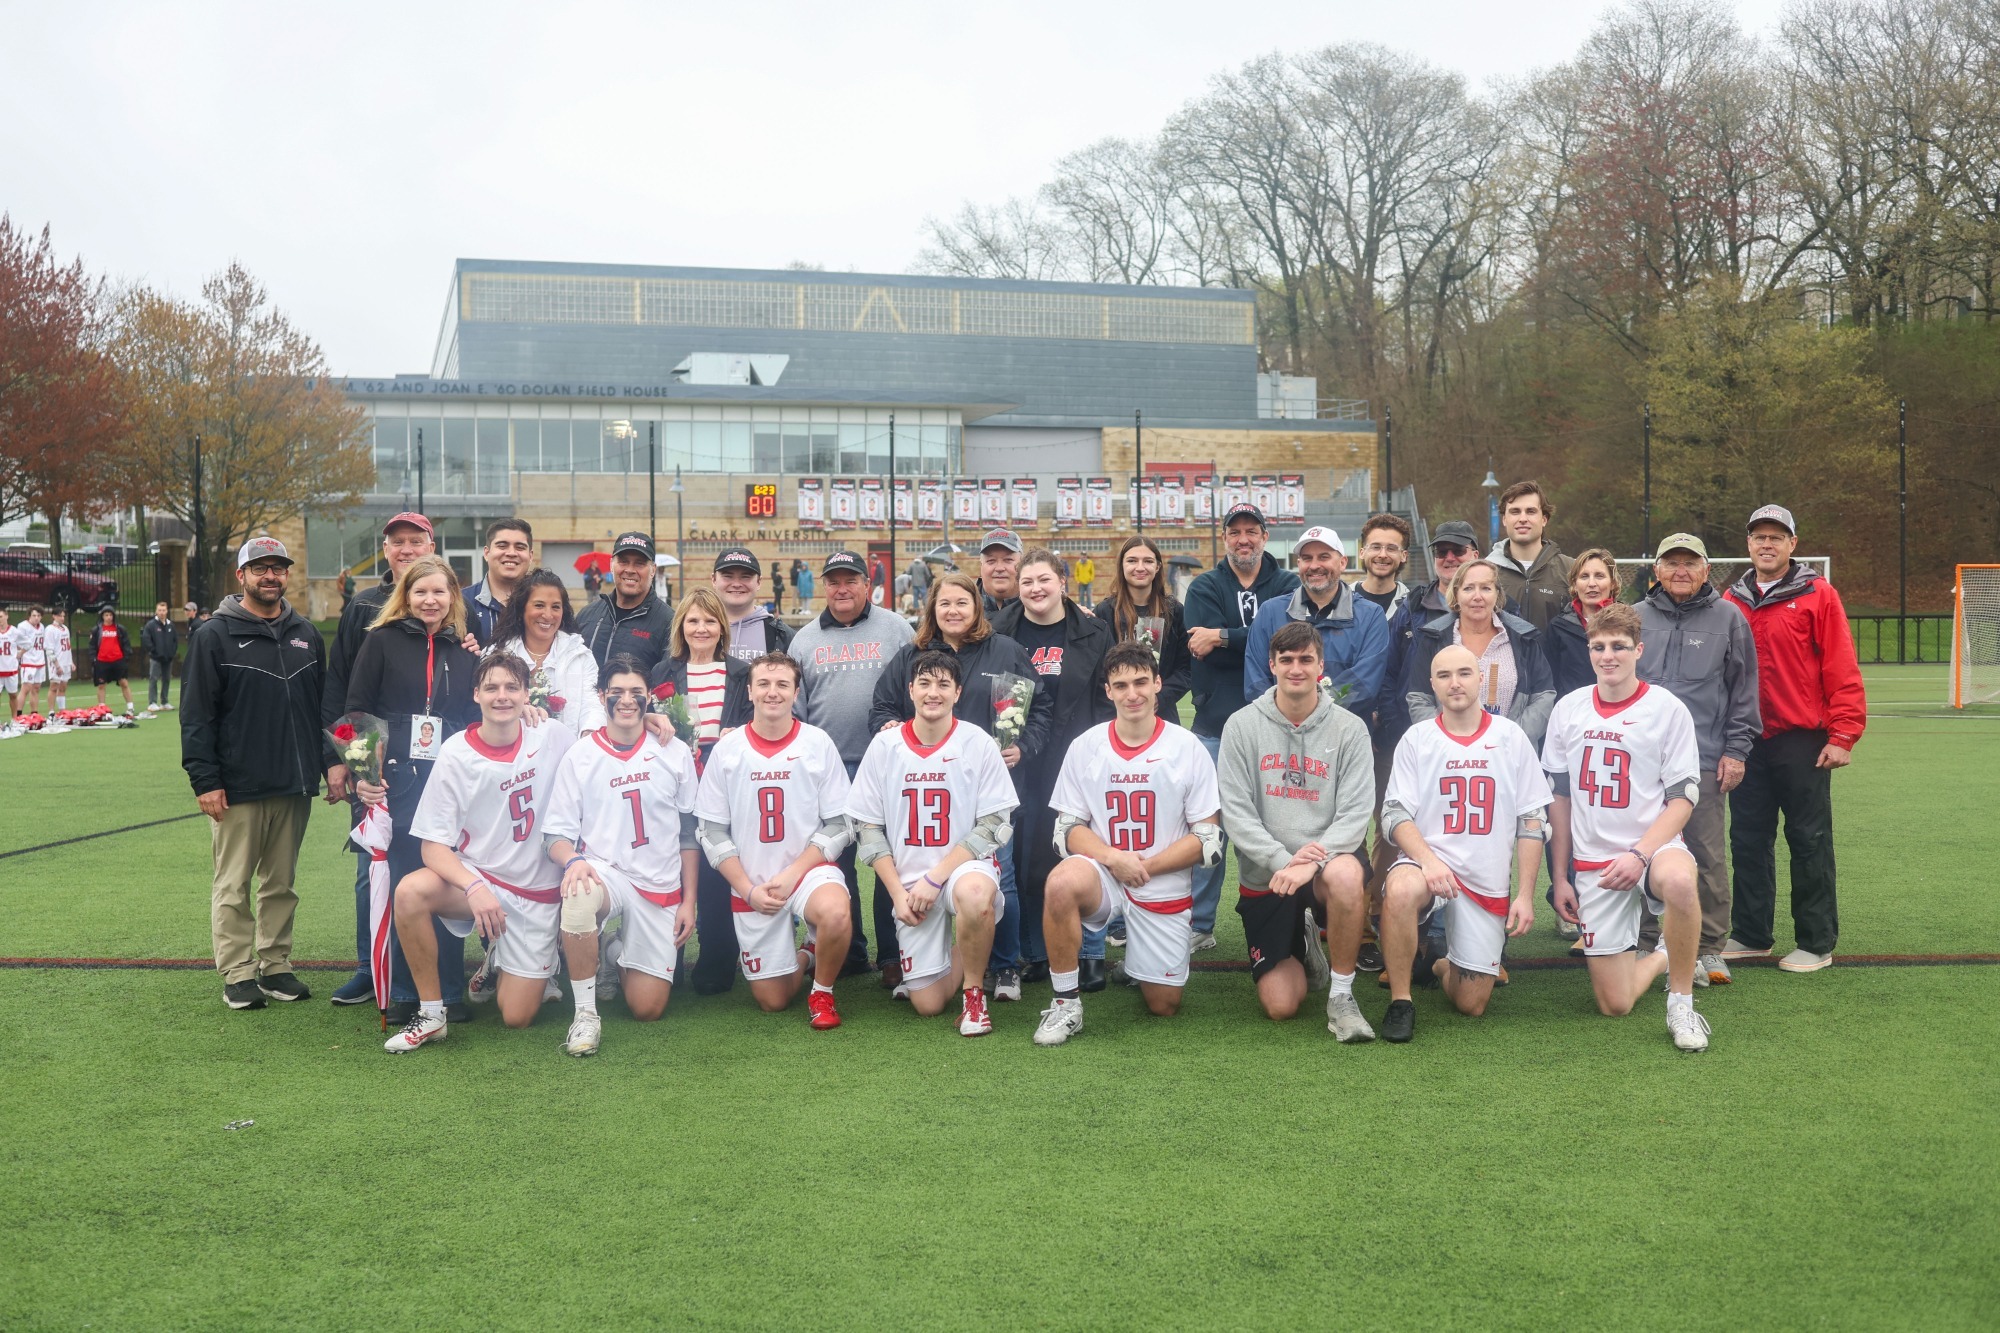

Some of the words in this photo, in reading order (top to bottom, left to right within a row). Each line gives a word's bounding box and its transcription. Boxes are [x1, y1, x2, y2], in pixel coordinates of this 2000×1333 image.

[363, 382, 385, 393] '62
[391, 382, 424, 393] AND
[432, 382, 470, 394] JOAN
[478, 383, 488, 394] E.
[494, 383, 516, 395] '60
[522, 384, 571, 396] DOLAN
[578, 385, 616, 397] FIELD
[624, 386, 668, 397] HOUSE
[754, 485, 775, 495] 6:23
[749, 496, 774, 515] 80
[689, 530, 738, 540] CLARK
[748, 530, 831, 540] UNIVERSITY
[815, 642, 882, 666] CLARK
[816, 662, 882, 674] LACROSSE
[1583, 729, 1624, 743] CLARK
[1260, 753, 1330, 780] CLARK
[1445, 759, 1489, 770] CLARK
[499, 767, 536, 792] CLARK
[610, 771, 651, 788] CLARK
[750, 771, 792, 781] CLARK
[905, 772, 946, 783] CLARK
[1110, 773, 1150, 784] CLARK
[1578, 745, 1632, 809] 43
[1266, 784, 1320, 802] LACROSSE
[508, 785, 535, 843] 5
[1439, 775, 1496, 836] 39
[622, 788, 650, 850] 1
[757, 786, 785, 844] 8
[901, 787, 951, 847] 13
[1105, 789, 1156, 852] 29
